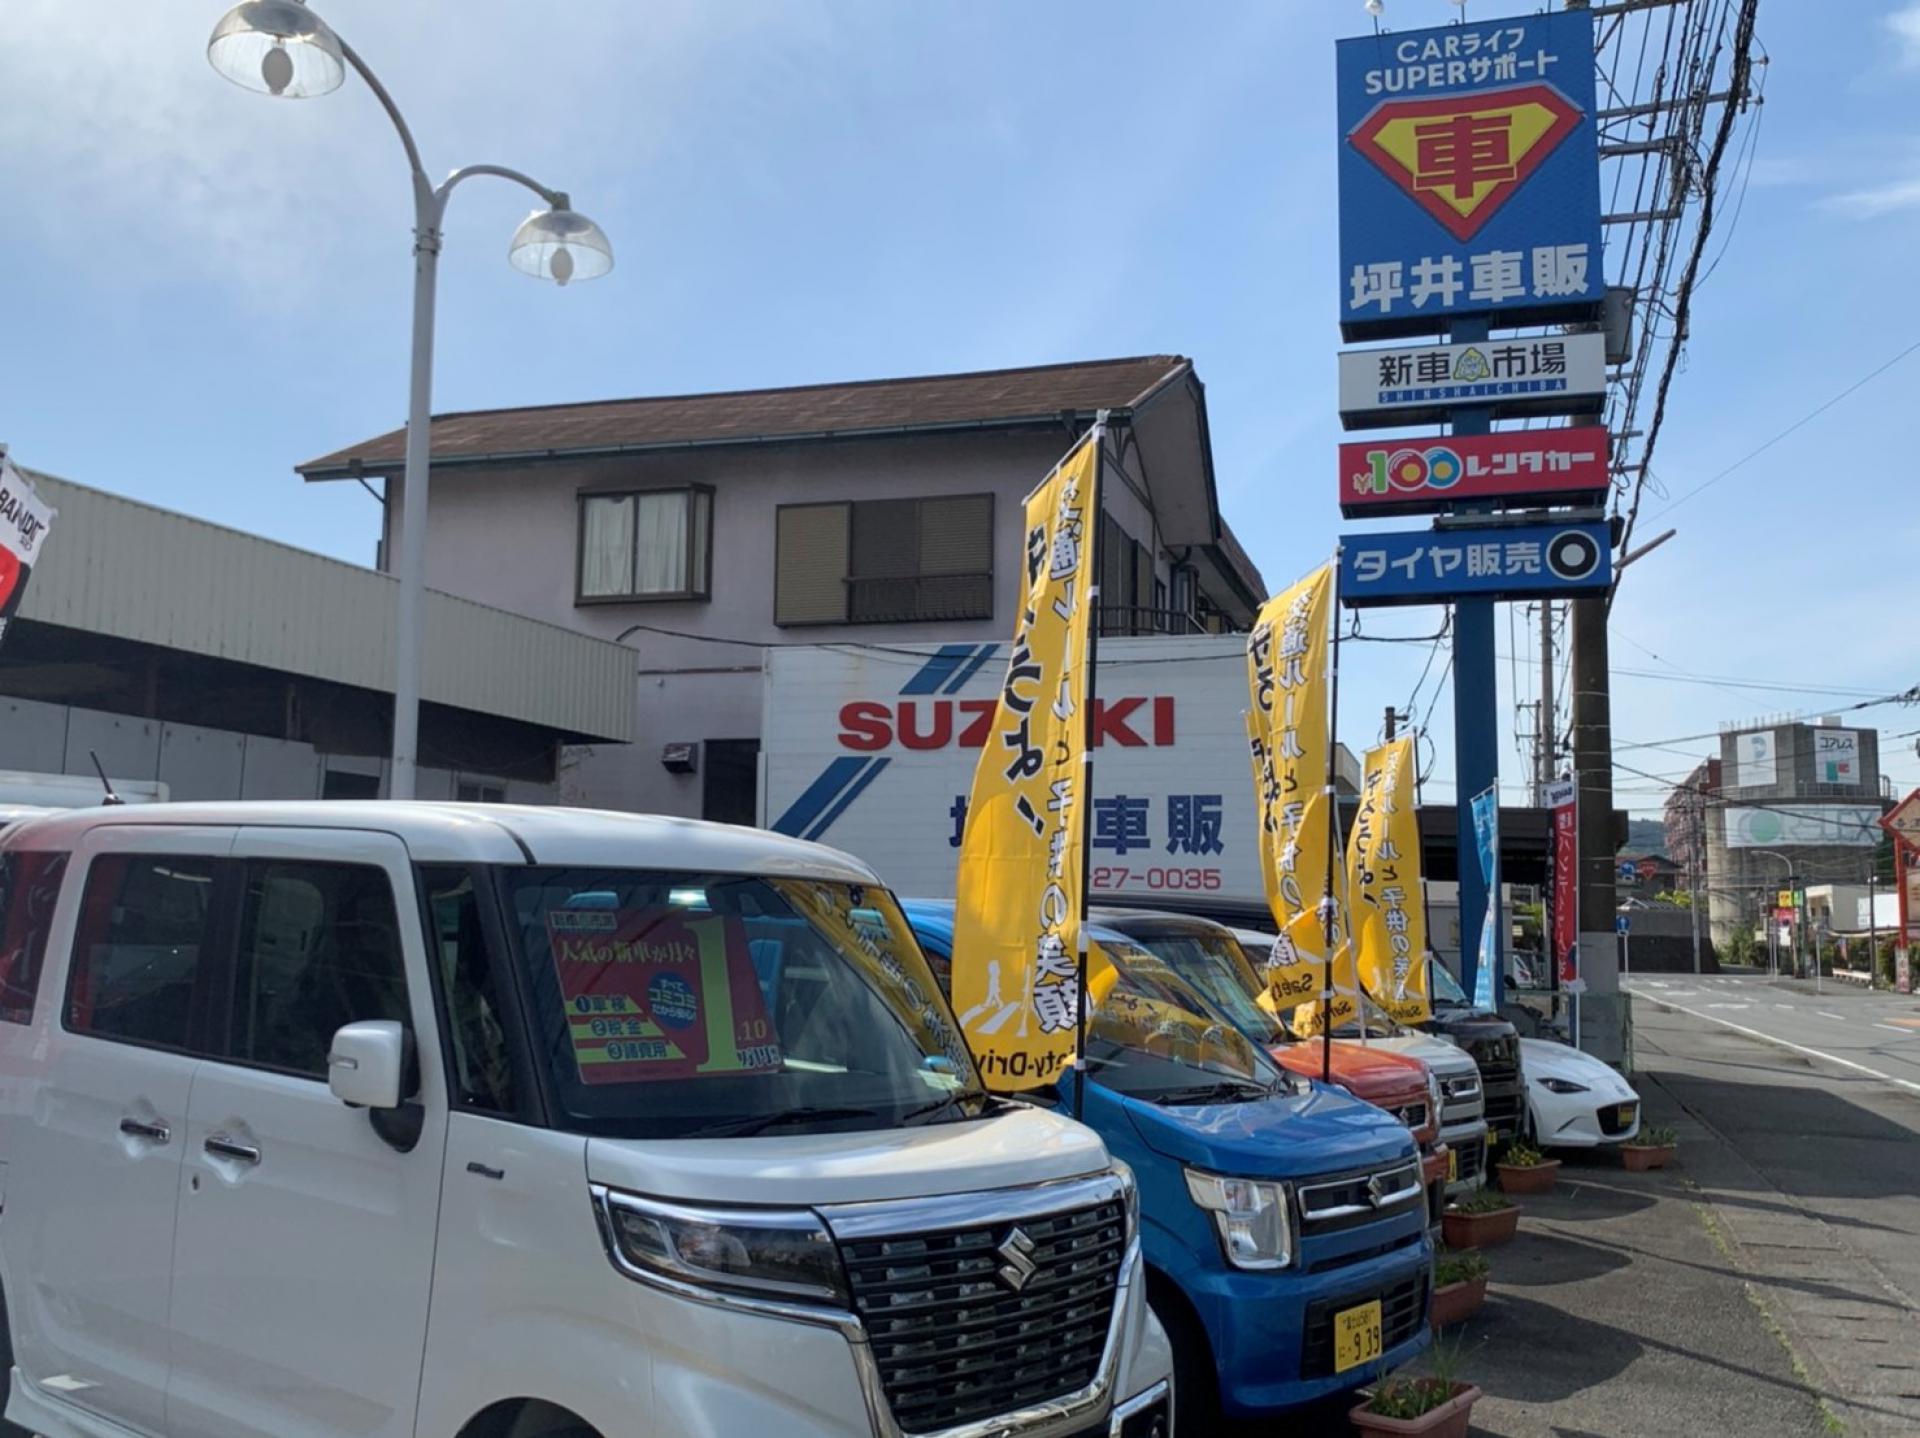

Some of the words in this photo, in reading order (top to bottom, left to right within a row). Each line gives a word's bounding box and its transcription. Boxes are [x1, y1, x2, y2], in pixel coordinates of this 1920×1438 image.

[1397, 27, 1525, 63] CARライフ
[1365, 49, 1559, 94] SUPERサポート
[1413, 113, 1517, 200] 車
[1350, 243, 1589, 313] 坪井車販
[1353, 541, 1541, 582] タイヤ販売
[1092, 867, 1222, 891] 27-0035
